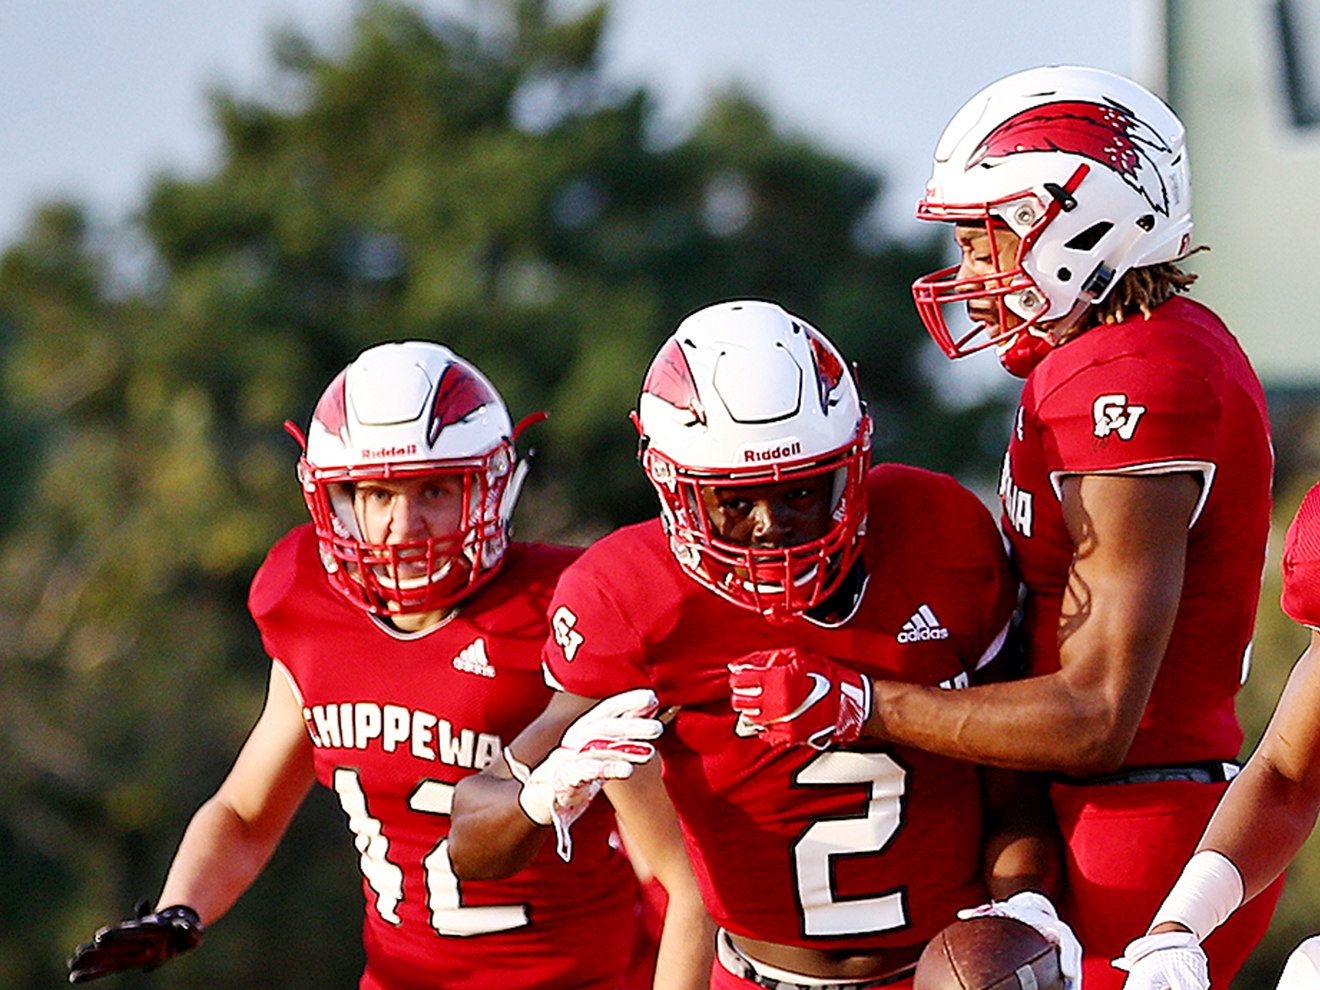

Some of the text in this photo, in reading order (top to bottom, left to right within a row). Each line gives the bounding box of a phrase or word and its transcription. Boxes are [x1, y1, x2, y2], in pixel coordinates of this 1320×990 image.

[744, 442, 801, 462] Riddell
[897, 626, 949, 644] adidas
[333, 767, 530, 937] 12
[795, 751, 907, 936] 2
